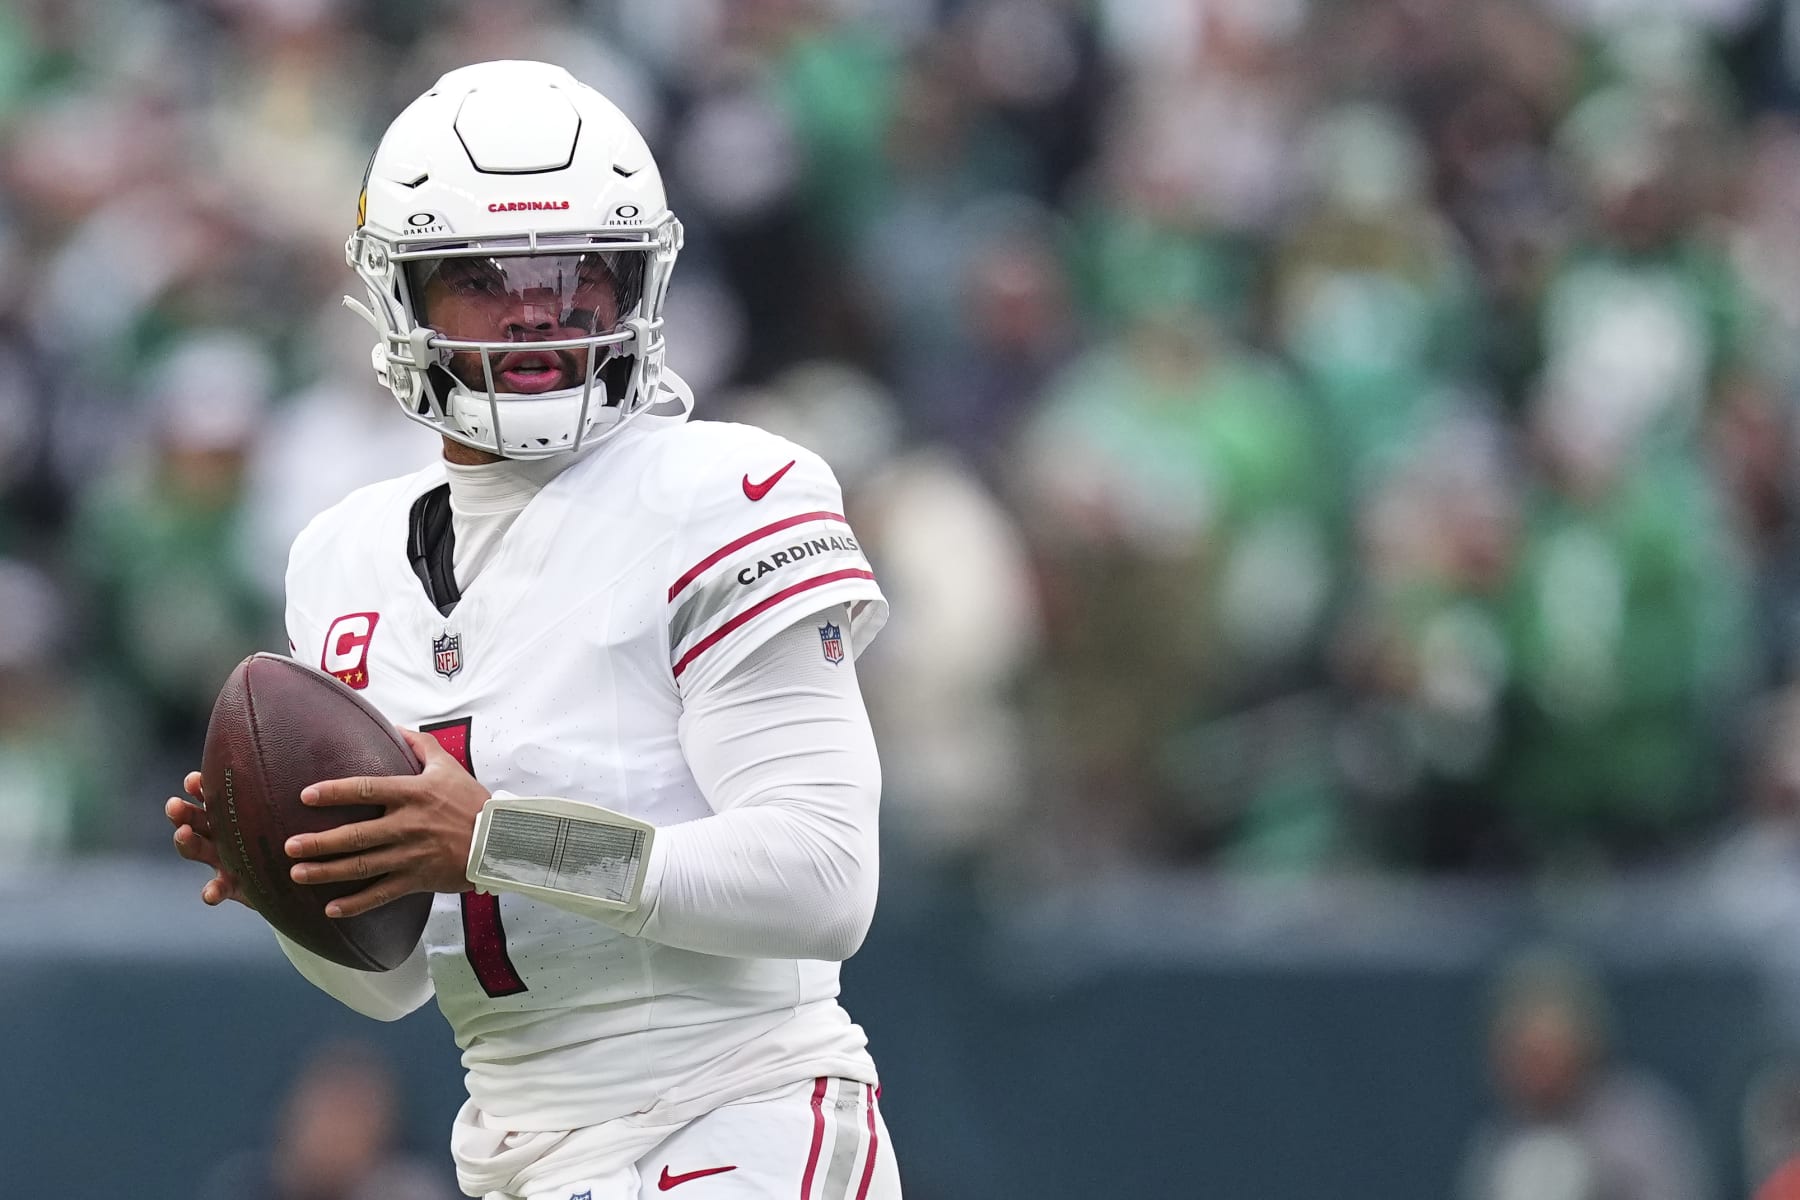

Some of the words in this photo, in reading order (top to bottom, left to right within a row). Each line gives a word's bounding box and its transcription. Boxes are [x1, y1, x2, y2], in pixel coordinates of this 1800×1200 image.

[488, 201, 570, 212] CARDINALS
[403, 225, 444, 236] OAKLEY
[737, 536, 859, 586] CARDINALS
[324, 615, 370, 674] C
[824, 638, 844, 660] NFL
[436, 650, 458, 672] NFL
[224, 768, 238, 823] LEAGUE
